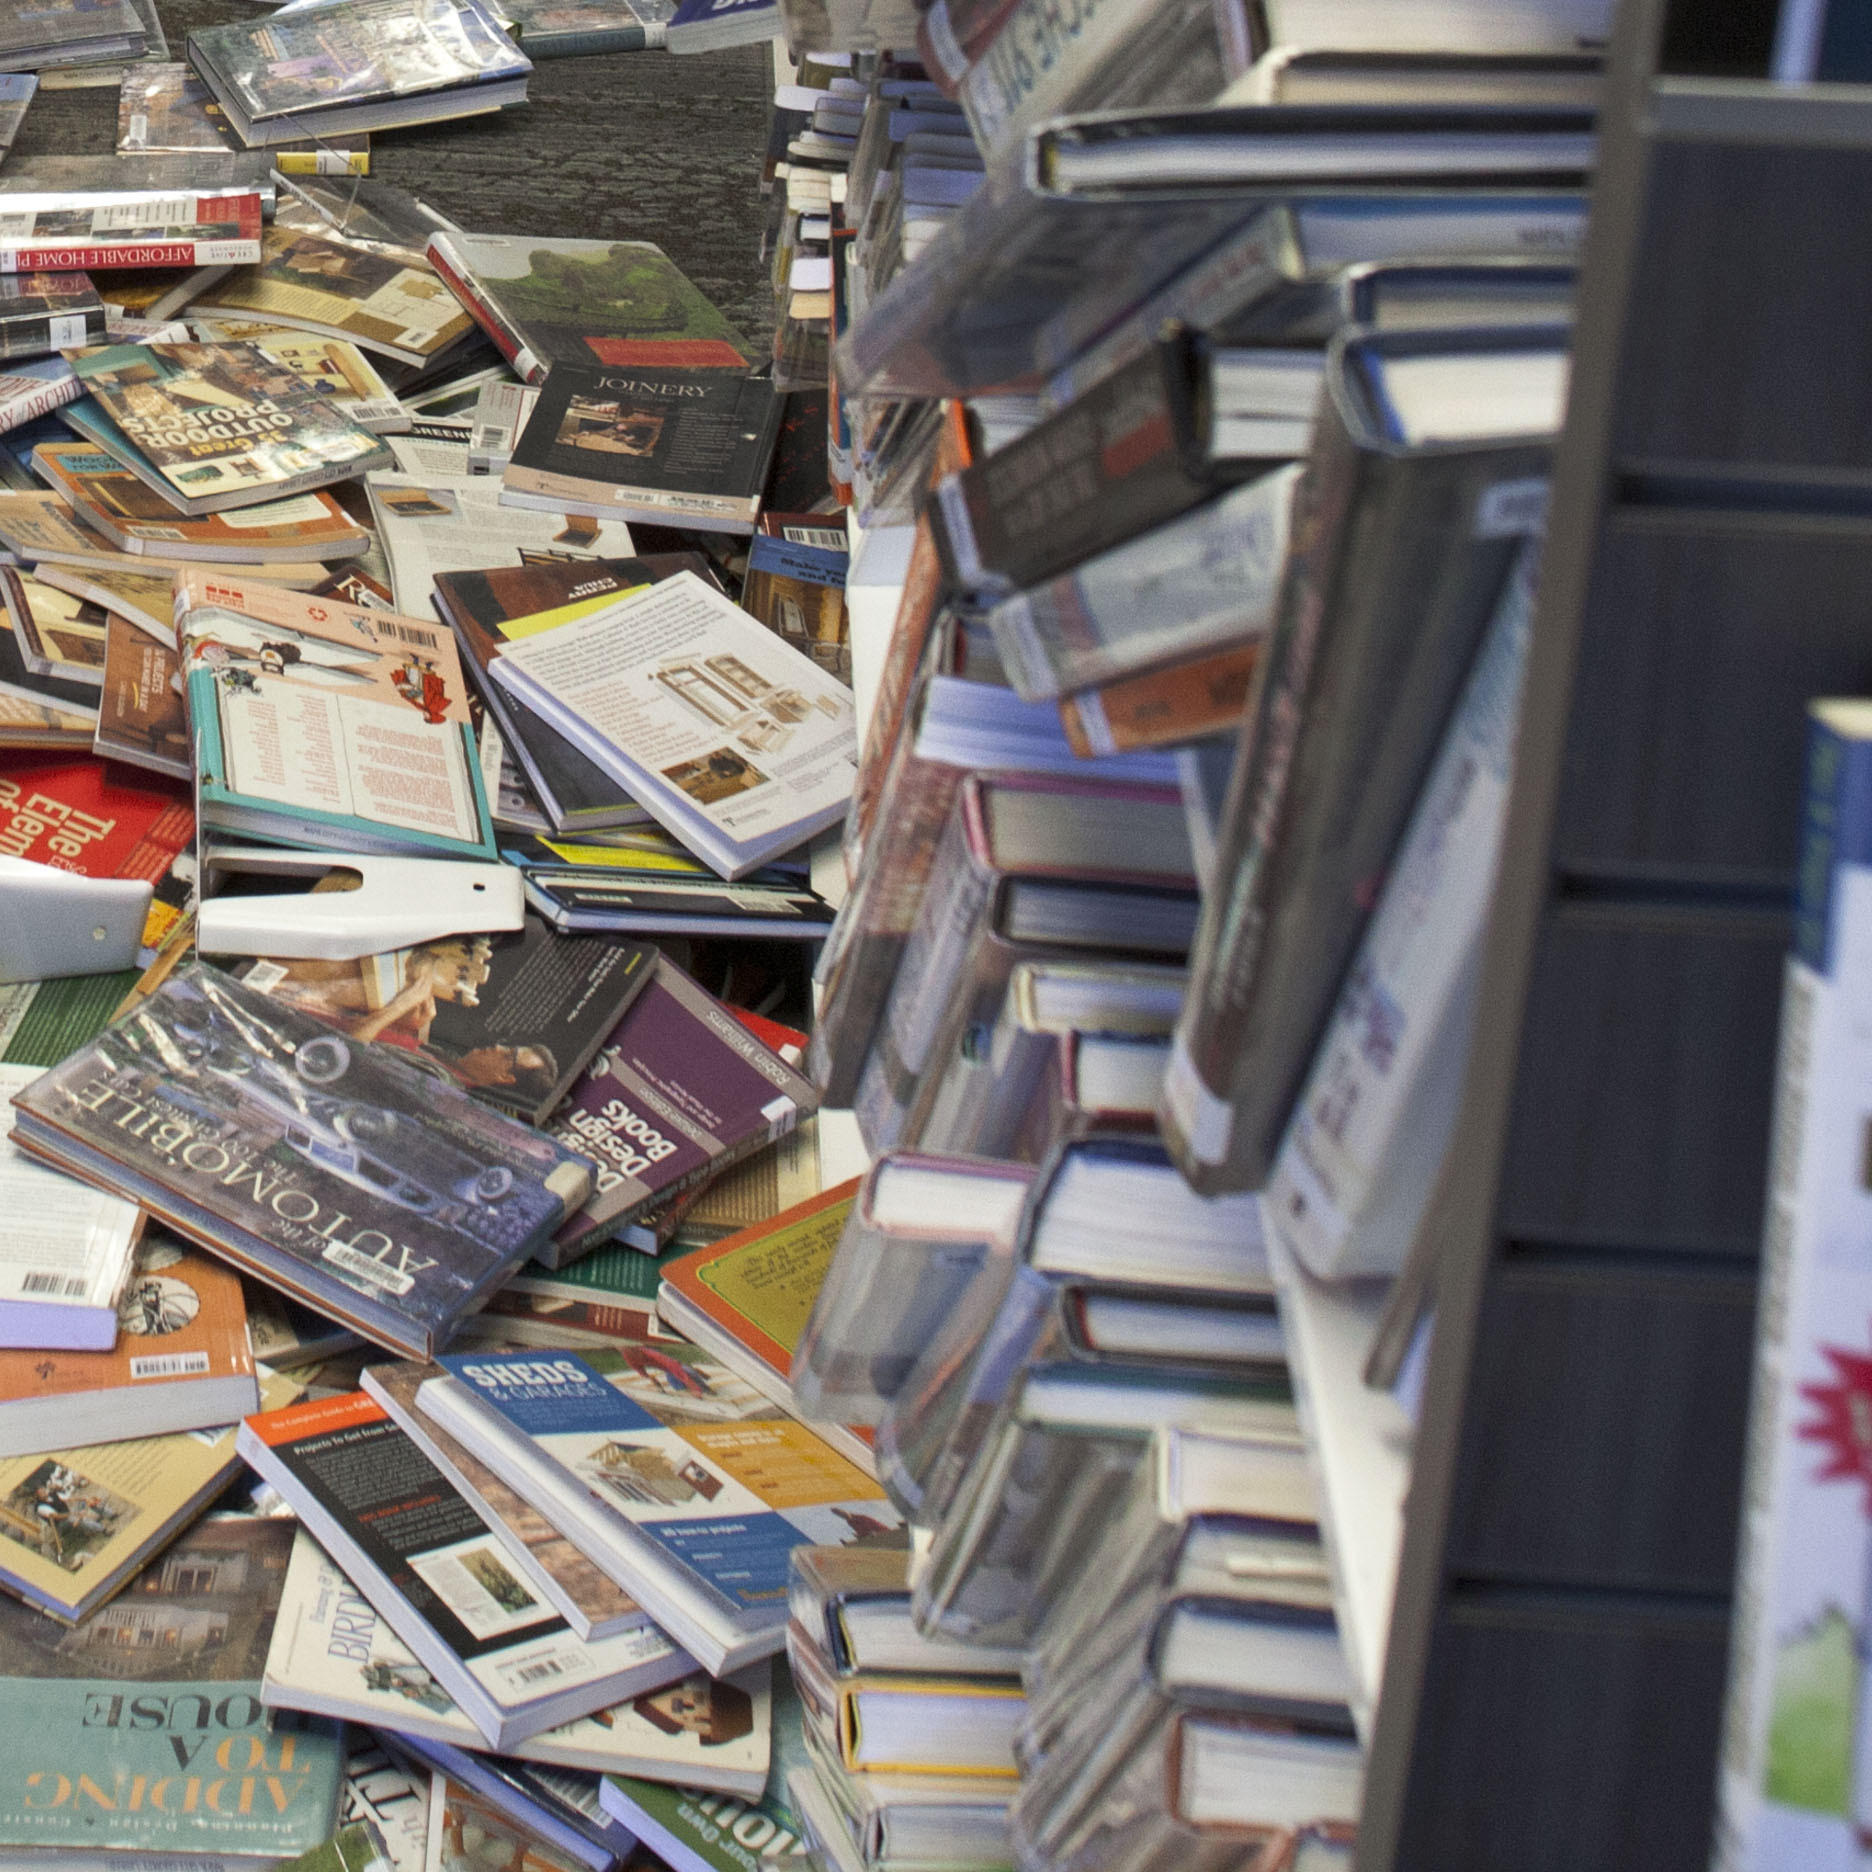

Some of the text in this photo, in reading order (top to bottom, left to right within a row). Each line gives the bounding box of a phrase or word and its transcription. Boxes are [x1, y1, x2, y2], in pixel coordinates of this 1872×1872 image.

[32, 247, 193, 267] AFFORDABLE HOME
[591, 375, 713, 398] JOINERY
[119, 397, 279, 434] PROJECTS
[138, 411, 293, 449] OUTDOOR
[188, 434, 253, 456] Great
[47, 804, 117, 859] The
[700, 1009, 794, 1088] Robin Williams
[568, 1108, 652, 1178] Design
[601, 1098, 678, 1162] Books
[74, 1071, 440, 1285] AUTOMOBILE
[462, 1359, 589, 1388] SHEDS
[489, 1381, 607, 1402] & GARAGES
[172, 1734, 314, 1773] TO A
[23, 1768, 308, 1816] ADDING
